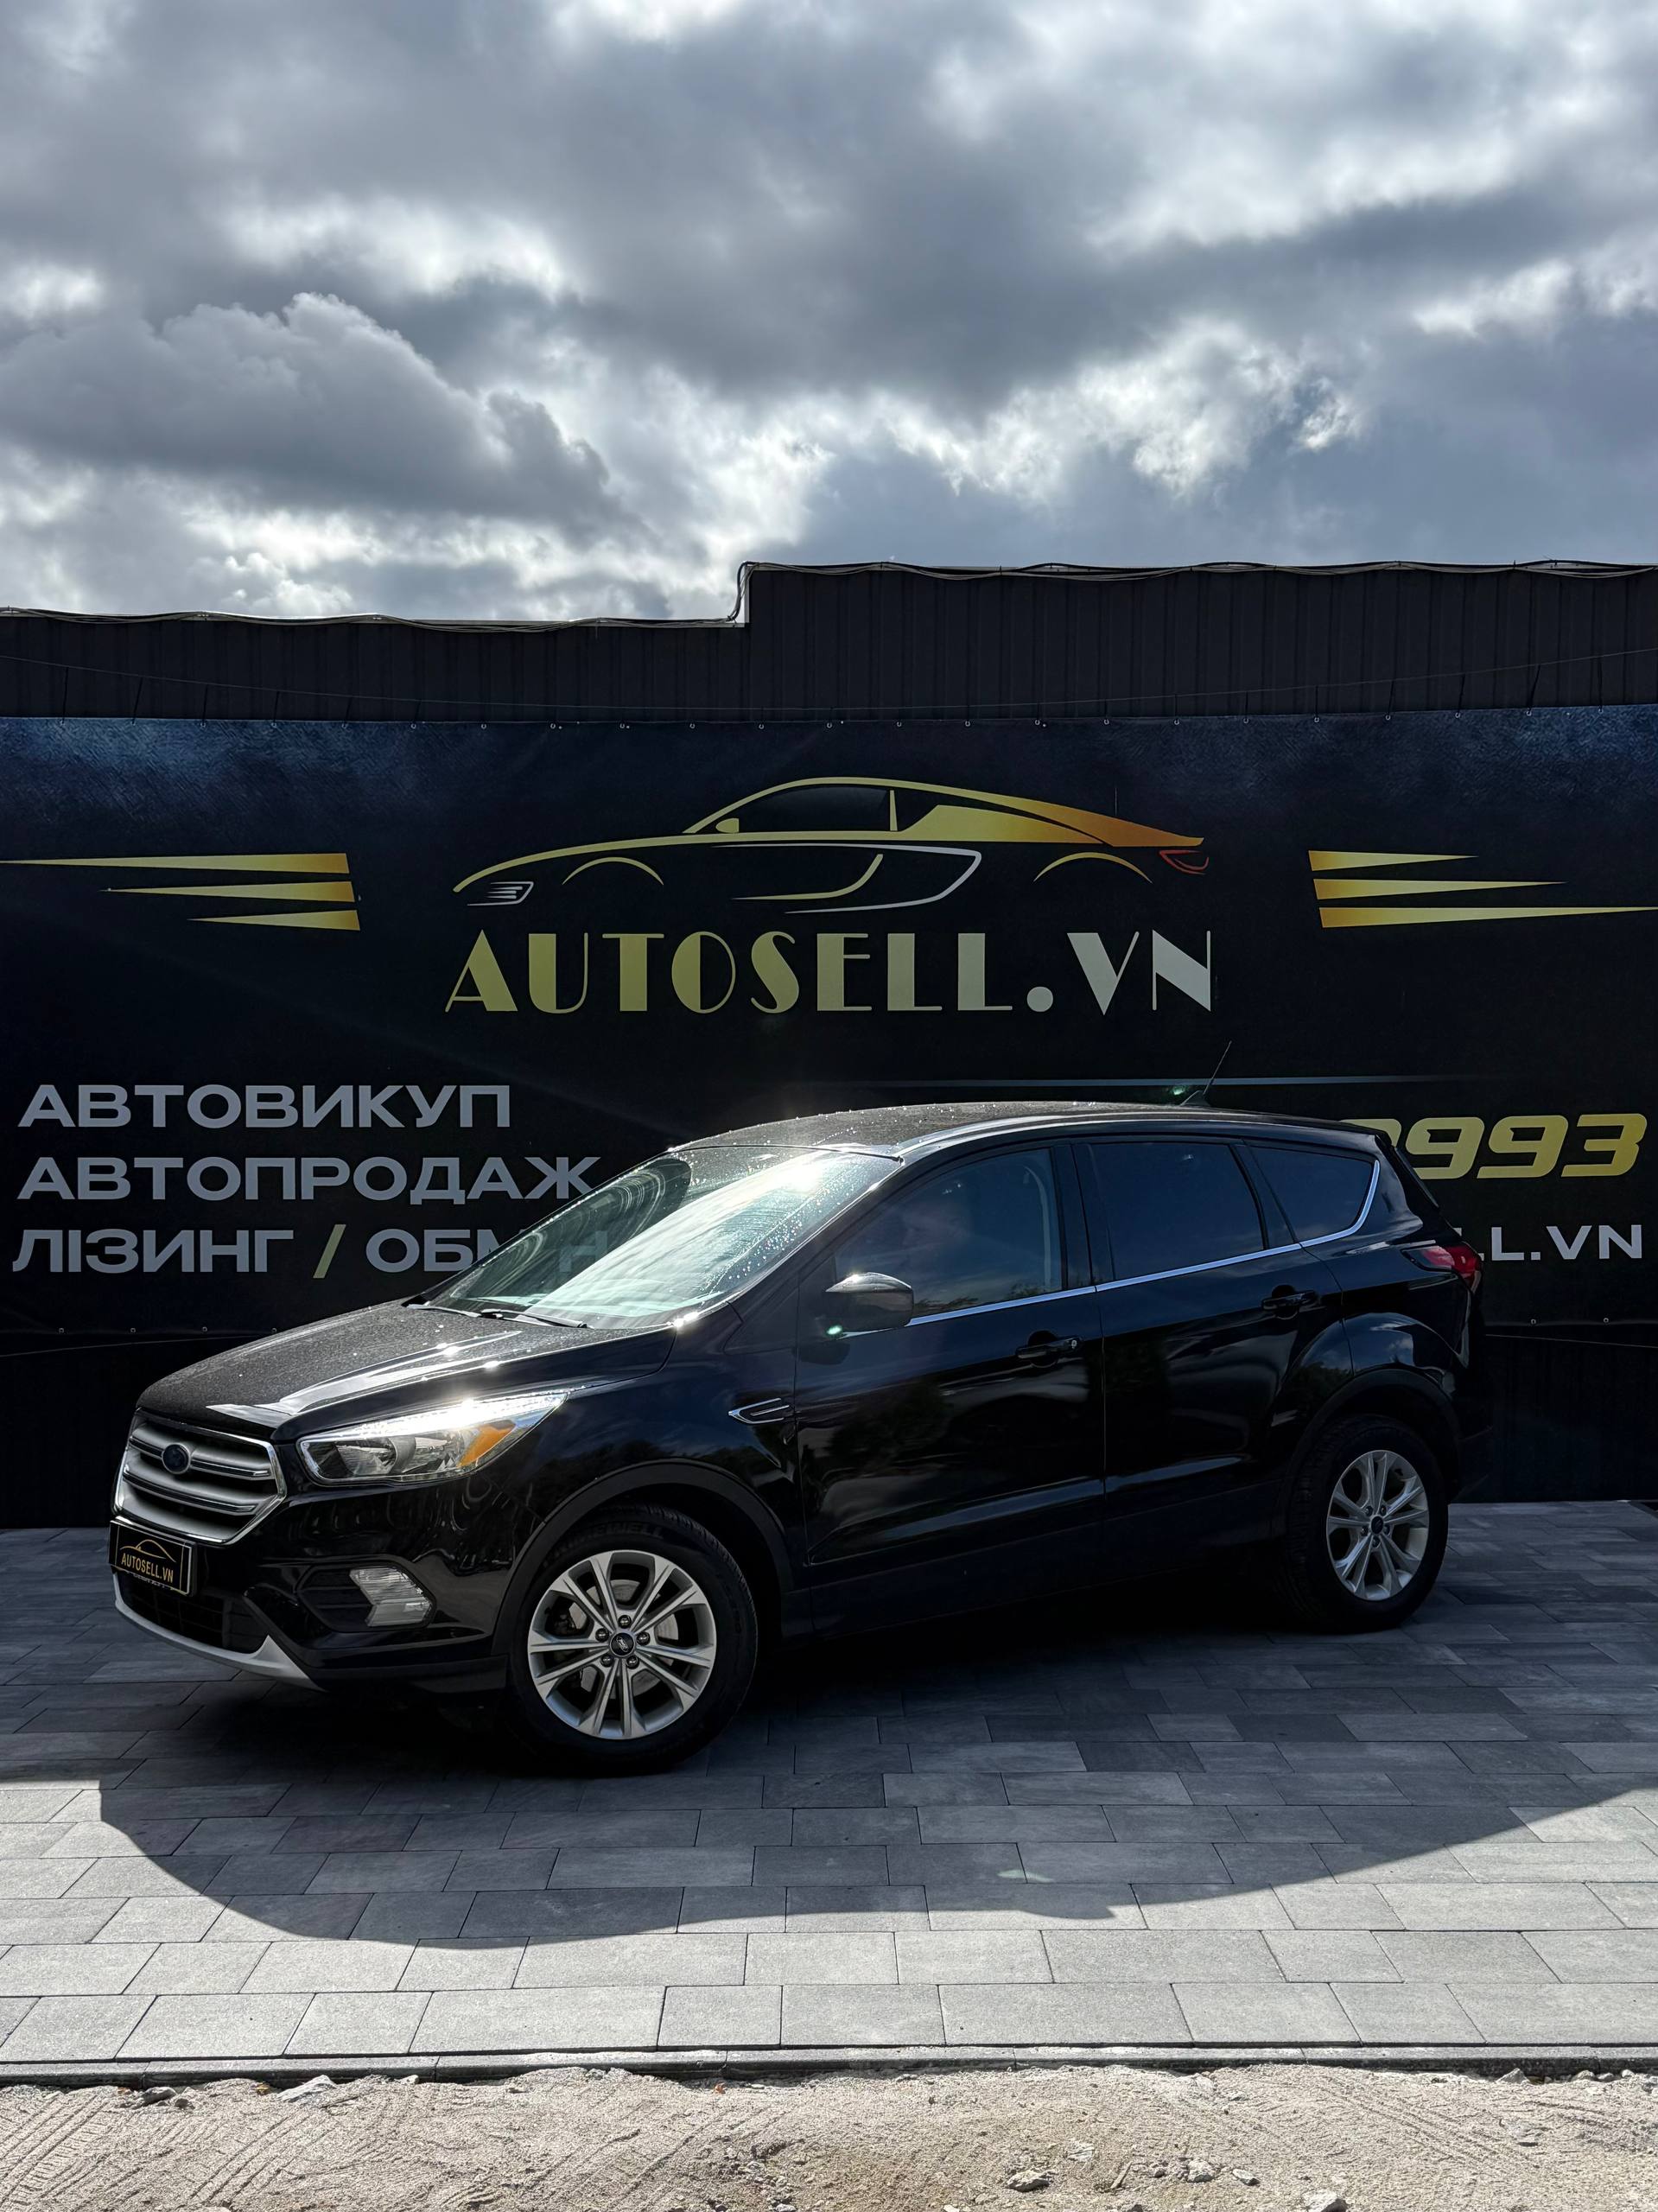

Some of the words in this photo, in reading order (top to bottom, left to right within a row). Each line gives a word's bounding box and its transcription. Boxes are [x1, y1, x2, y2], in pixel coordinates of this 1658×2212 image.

[445, 929, 1211, 1015] AUTOSELL.VN
[17, 1084, 511, 1128] АВТОВИКУП
[16, 1156, 600, 1205] АВТОПРОДАЖ
[12, 1228, 294, 1273] ЛІЗИНГ
[1453, 1224, 1642, 1262] L.VN
[122, 1554, 174, 1583] AUTOSELL.VN
